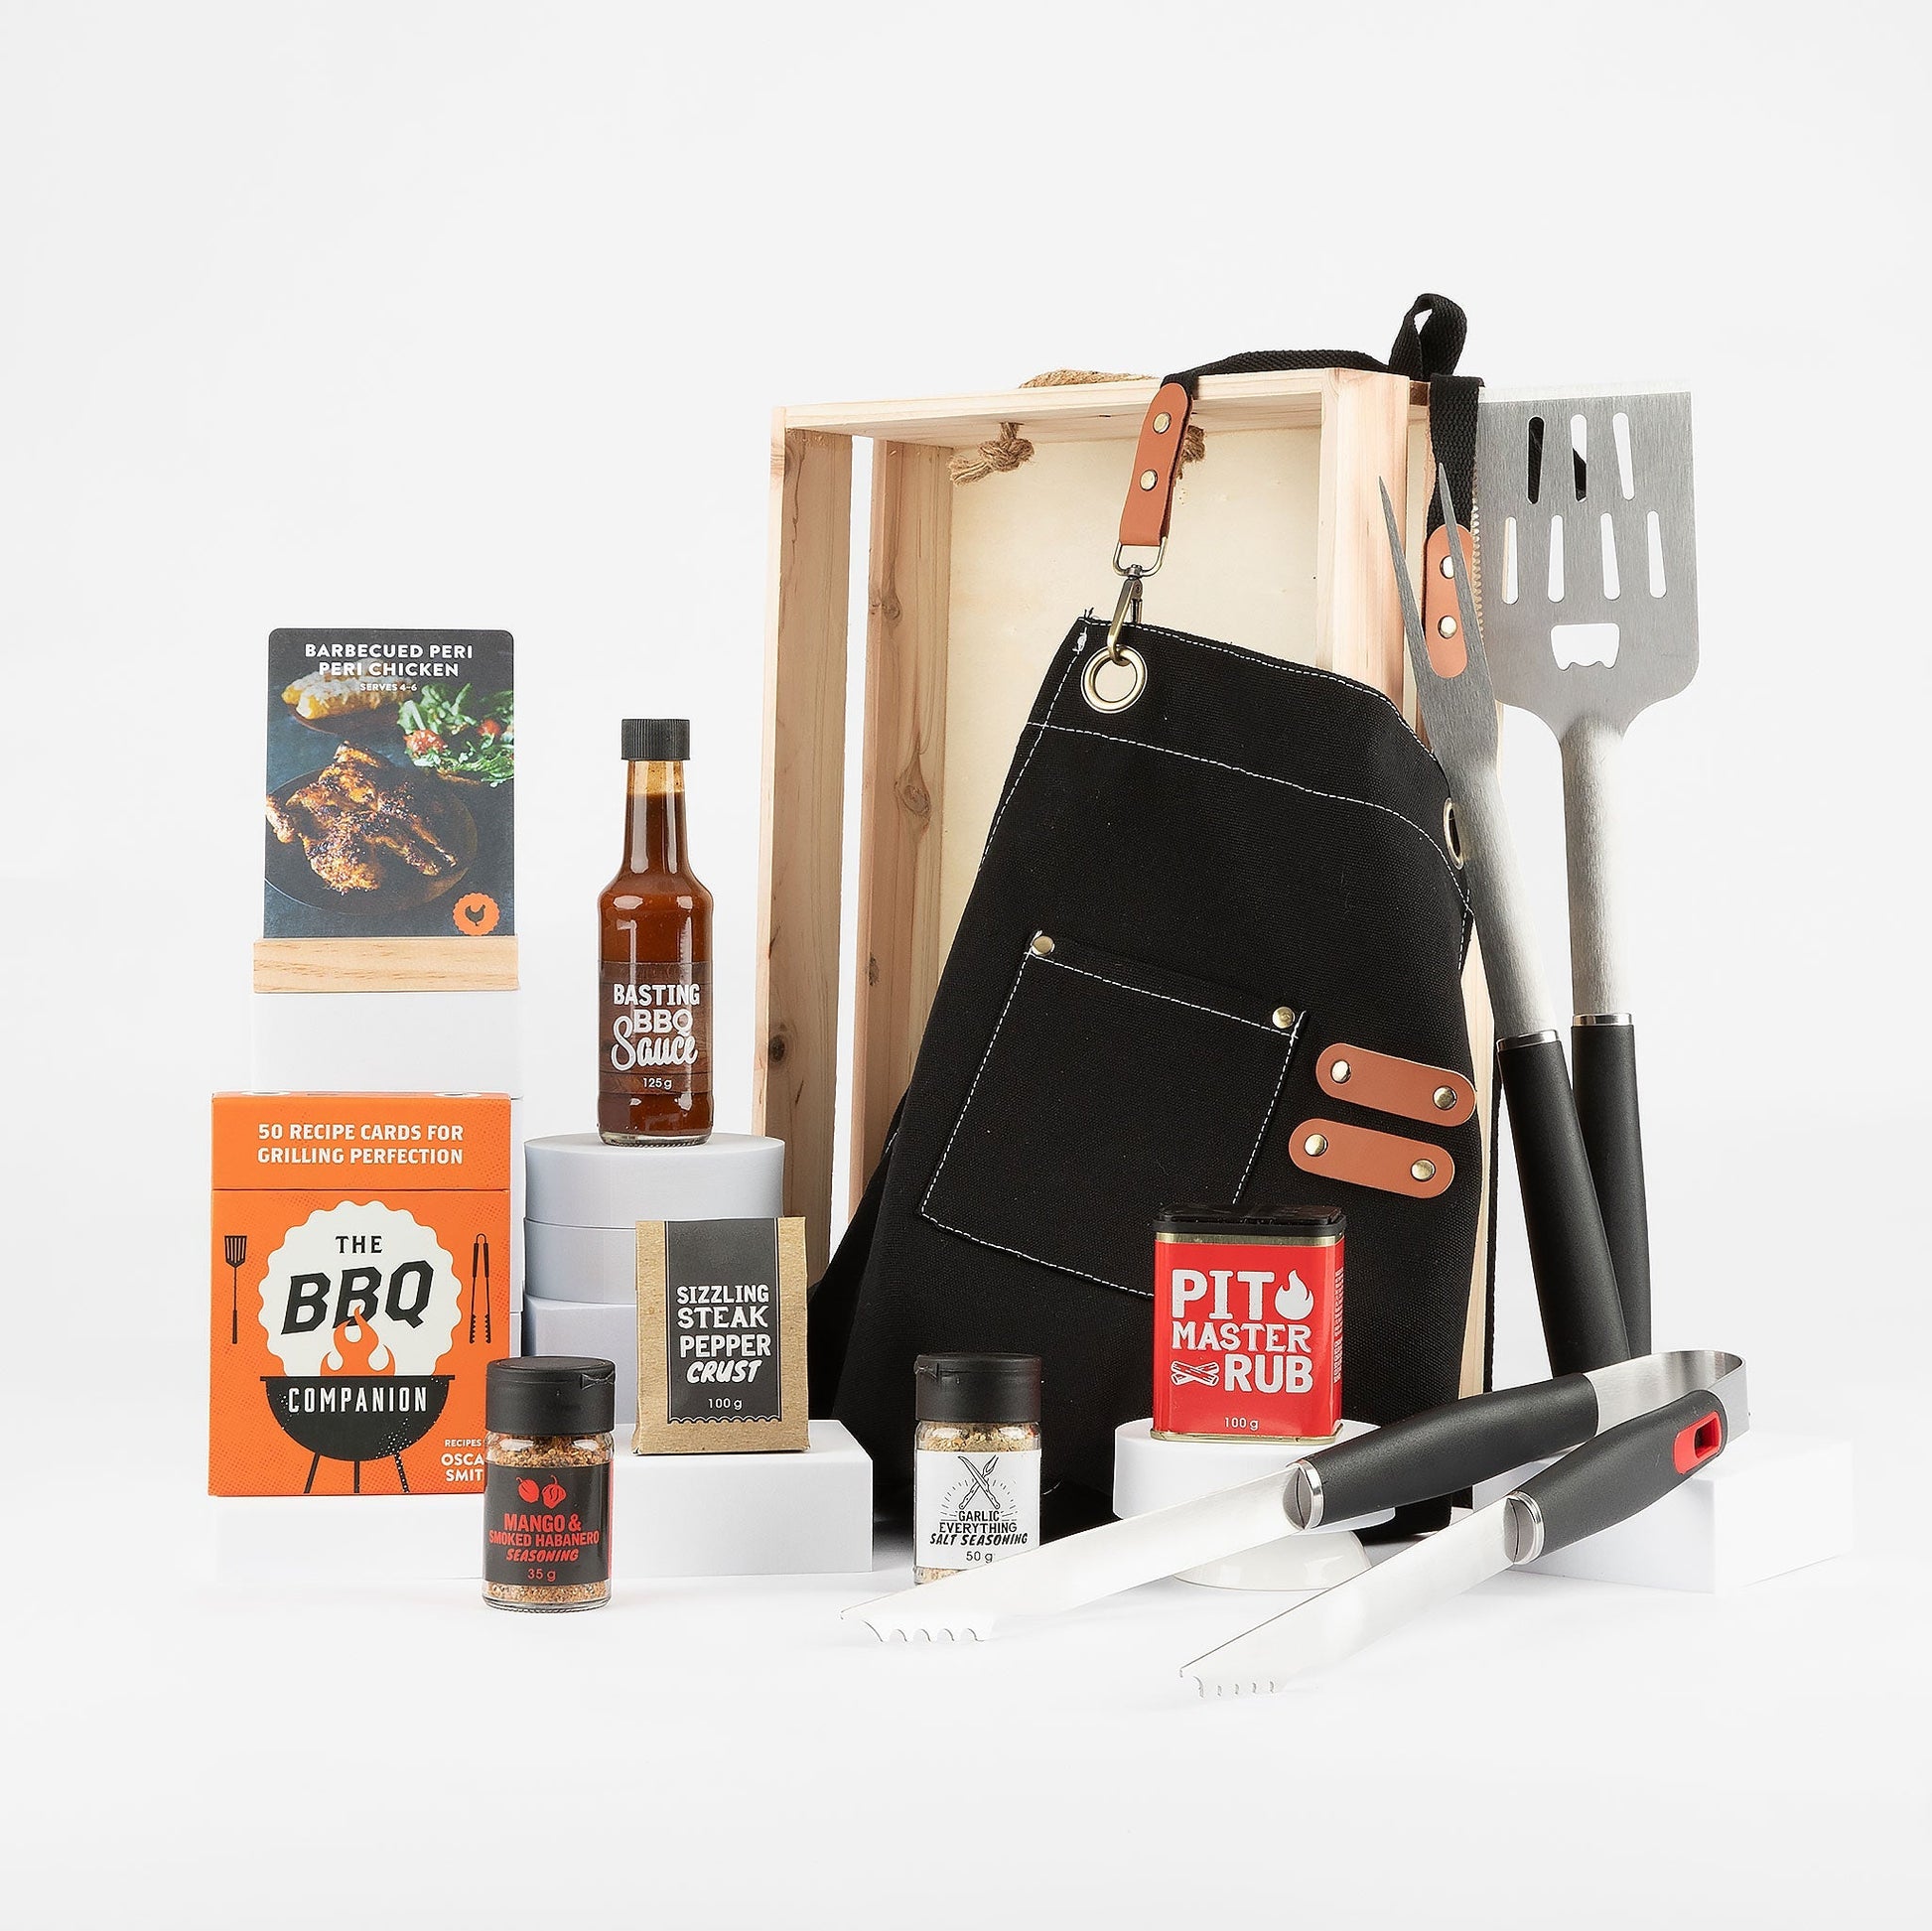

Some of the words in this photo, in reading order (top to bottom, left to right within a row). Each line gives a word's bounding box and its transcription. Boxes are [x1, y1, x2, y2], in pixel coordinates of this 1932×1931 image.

[305, 643, 423, 658] BARBECUED
[429, 644, 473, 659] PERI
[319, 662, 362, 676] PERI
[368, 662, 459, 677] CHICKEN
[359, 683, 398, 692] SERVES
[399, 683, 417, 692] 4-6
[613, 984, 700, 1006] BASTING
[633, 1009, 693, 1036] BBQ
[611, 1015, 698, 1071] Sauce
[643, 1077, 662, 1088] 125
[663, 1079, 672, 1089] g
[258, 1124, 283, 1140] 50
[289, 1124, 355, 1140] RECIPE
[360, 1125, 422, 1141] CARDS
[427, 1125, 464, 1141] FOR
[257, 1148, 345, 1165] GRILLING
[349, 1148, 464, 1165] PERFECTION
[335, 1235, 382, 1254] THE
[281, 1260, 435, 1335] BBQ
[676, 1284, 769, 1305] SIZZLING
[1172, 1269, 1276, 1320] PIT
[678, 1306, 768, 1328] STEAK
[679, 1333, 771, 1358] PEPPER
[1172, 1321, 1311, 1353] MASTER
[687, 1360, 761, 1383] CRUST
[1224, 1354, 1312, 1393] RUB
[288, 1387, 427, 1413] COMPANION
[709, 1398, 731, 1409] 100
[734, 1401, 743, 1411] g
[1224, 1417, 1247, 1429] 100
[1250, 1420, 1259, 1431] g
[445, 1439, 482, 1448] RECIPES
[441, 1452, 484, 1466] OSCA
[446, 1468, 483, 1481] SMIT
[503, 1513, 565, 1532] MANGO
[568, 1513, 581, 1532] &
[958, 1510, 1000, 1522] GARLIC
[939, 1522, 1018, 1534] EVERYTHING
[488, 1530, 531, 1547] SMOKED
[535, 1530, 600, 1547] HABANERO
[929, 1533, 957, 1546] SALT
[960, 1533, 1028, 1546] SEASONING
[506, 1548, 579, 1563] SEASONING
[966, 1551, 980, 1562] 50
[985, 1553, 993, 1563] g
[527, 1568, 543, 1580] 35
[547, 1571, 556, 1582] g
